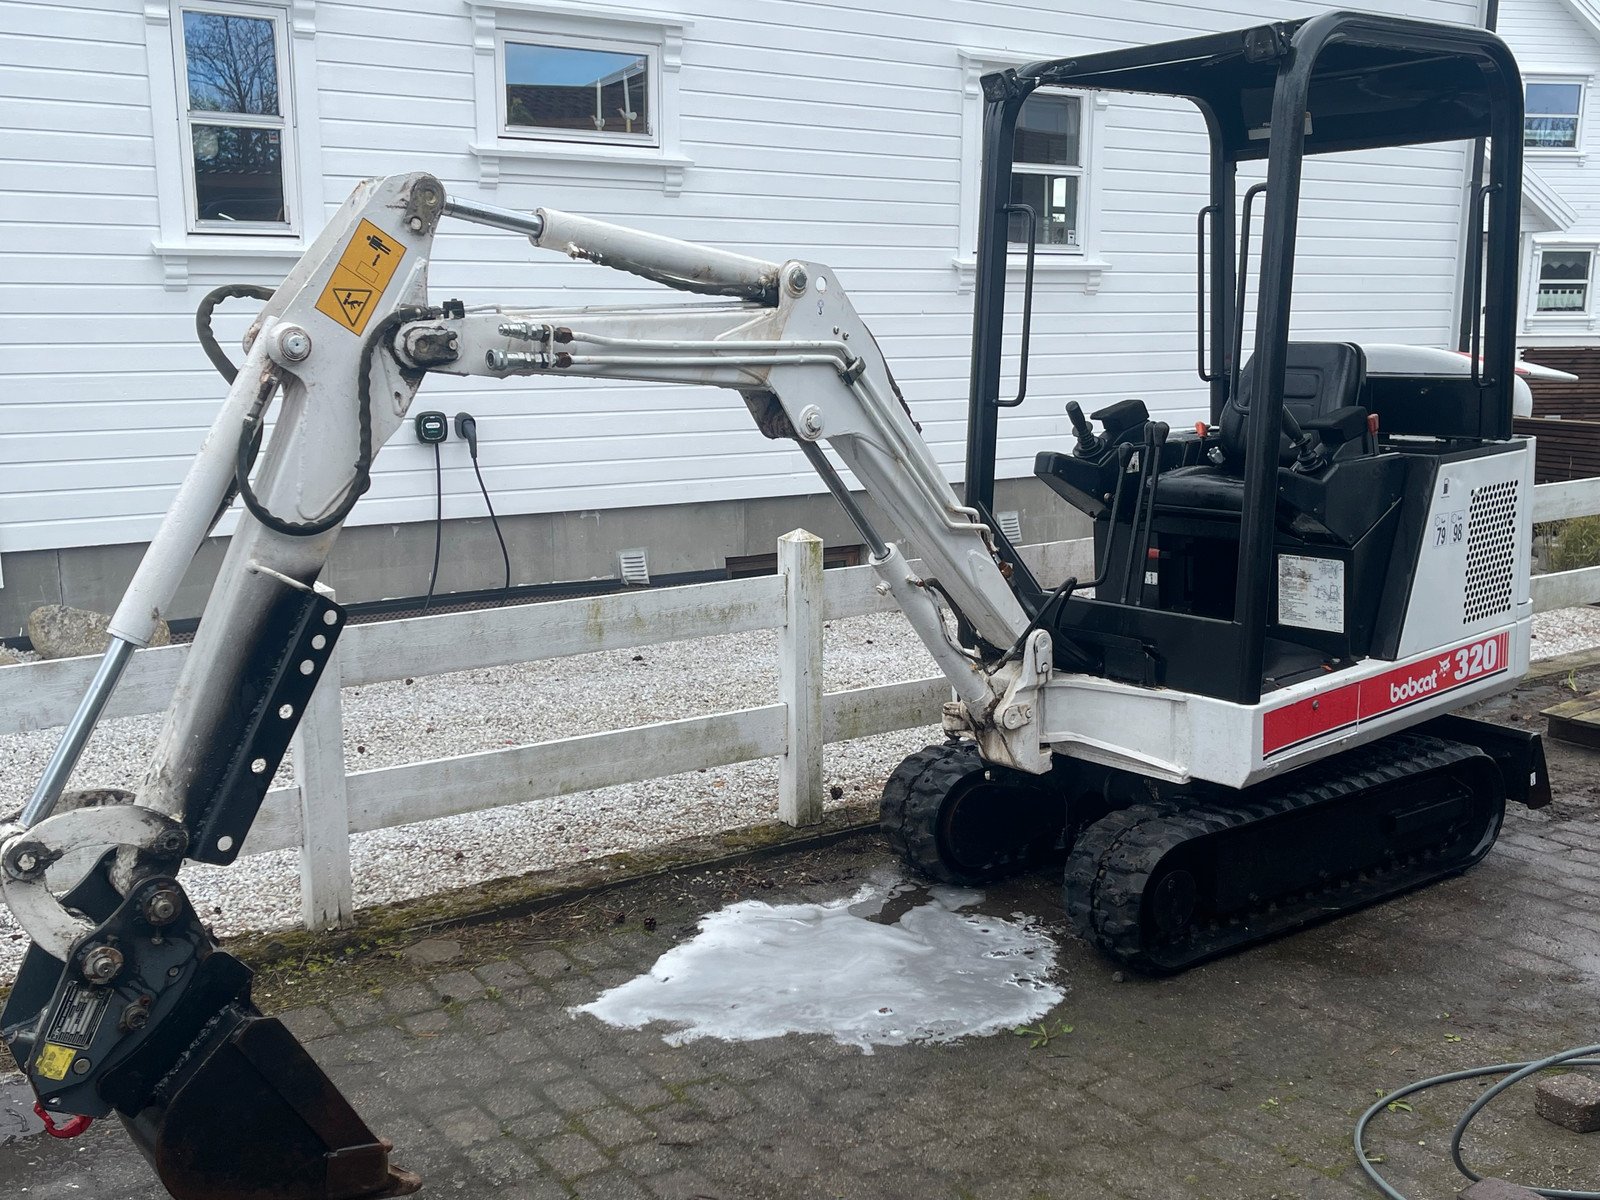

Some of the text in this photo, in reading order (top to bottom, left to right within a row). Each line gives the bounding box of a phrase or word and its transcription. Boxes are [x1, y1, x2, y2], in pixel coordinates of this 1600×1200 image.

[1437, 527, 1446, 545] 79
[1453, 523, 1462, 542] 98
[1390, 639, 1497, 703] bobcat 320
